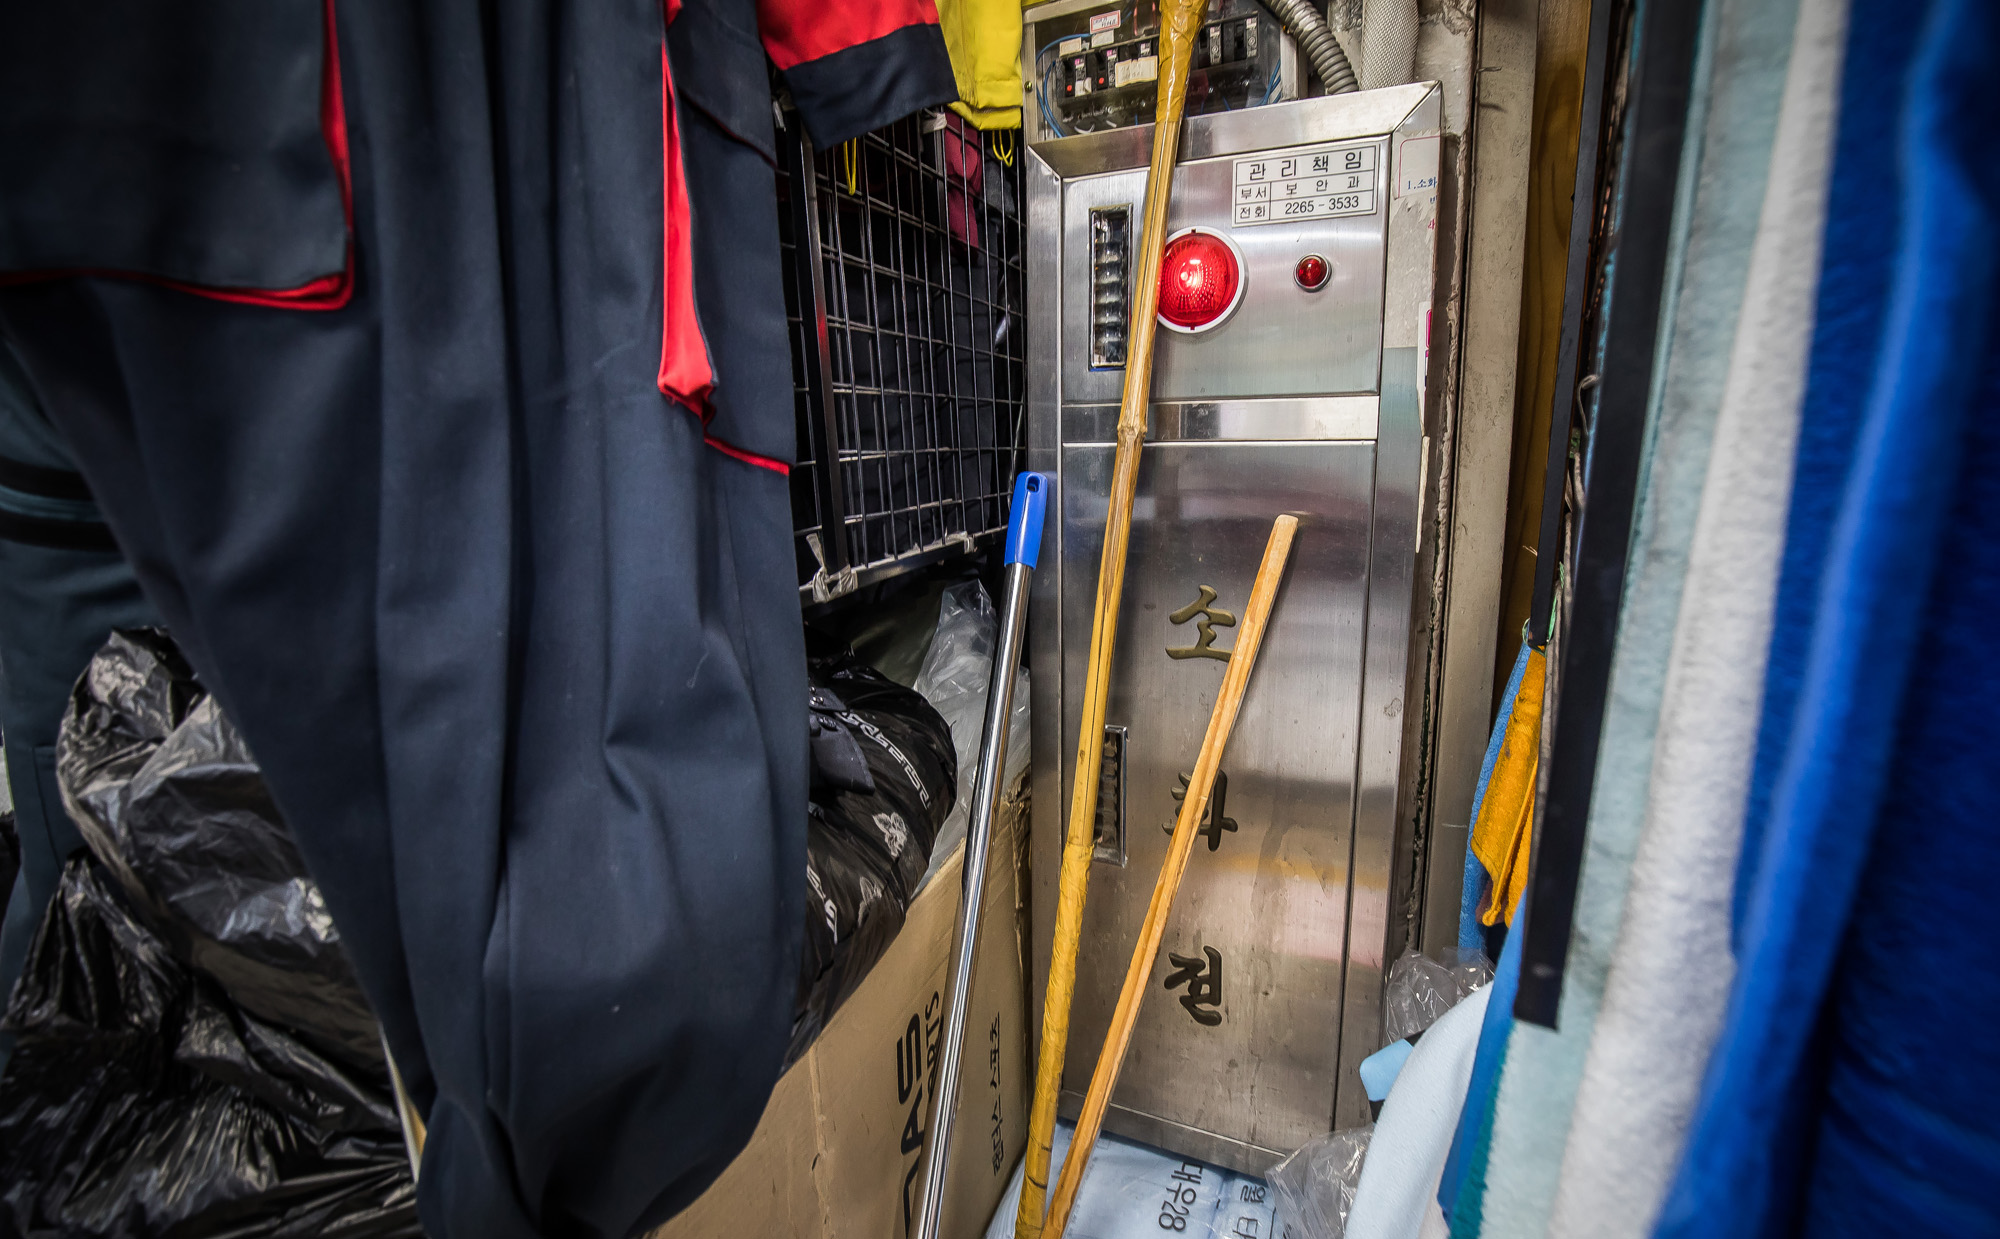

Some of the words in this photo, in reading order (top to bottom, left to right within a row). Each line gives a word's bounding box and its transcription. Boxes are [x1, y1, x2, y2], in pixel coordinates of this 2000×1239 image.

[1240, 186, 1267, 199] 부서
[1239, 205, 1266, 219] 전화
[989, 1011, 1001, 1090] 스포츠
